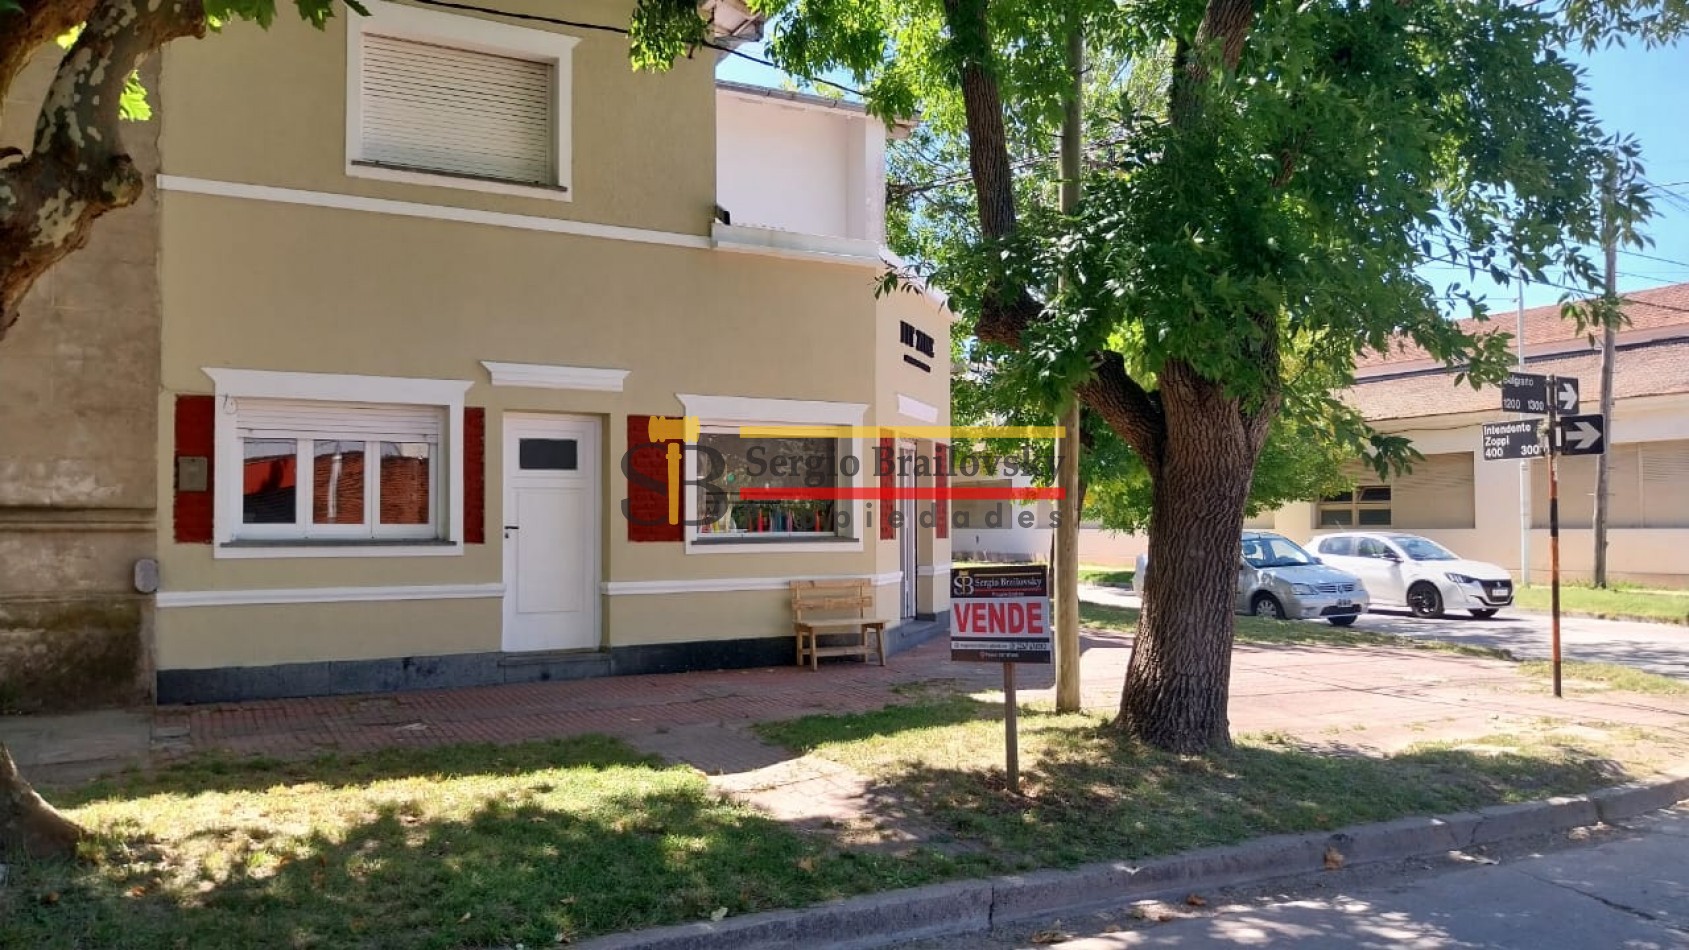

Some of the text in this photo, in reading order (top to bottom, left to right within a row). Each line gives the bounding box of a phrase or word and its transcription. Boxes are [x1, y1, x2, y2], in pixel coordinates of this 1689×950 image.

[1527, 400, 1545, 411] 1300
[1484, 422, 1532, 435] Intendente
[1485, 435, 1510, 447] Zoppi
[1485, 445, 1540, 458] 400 300
[954, 603, 1043, 633] VENDE
